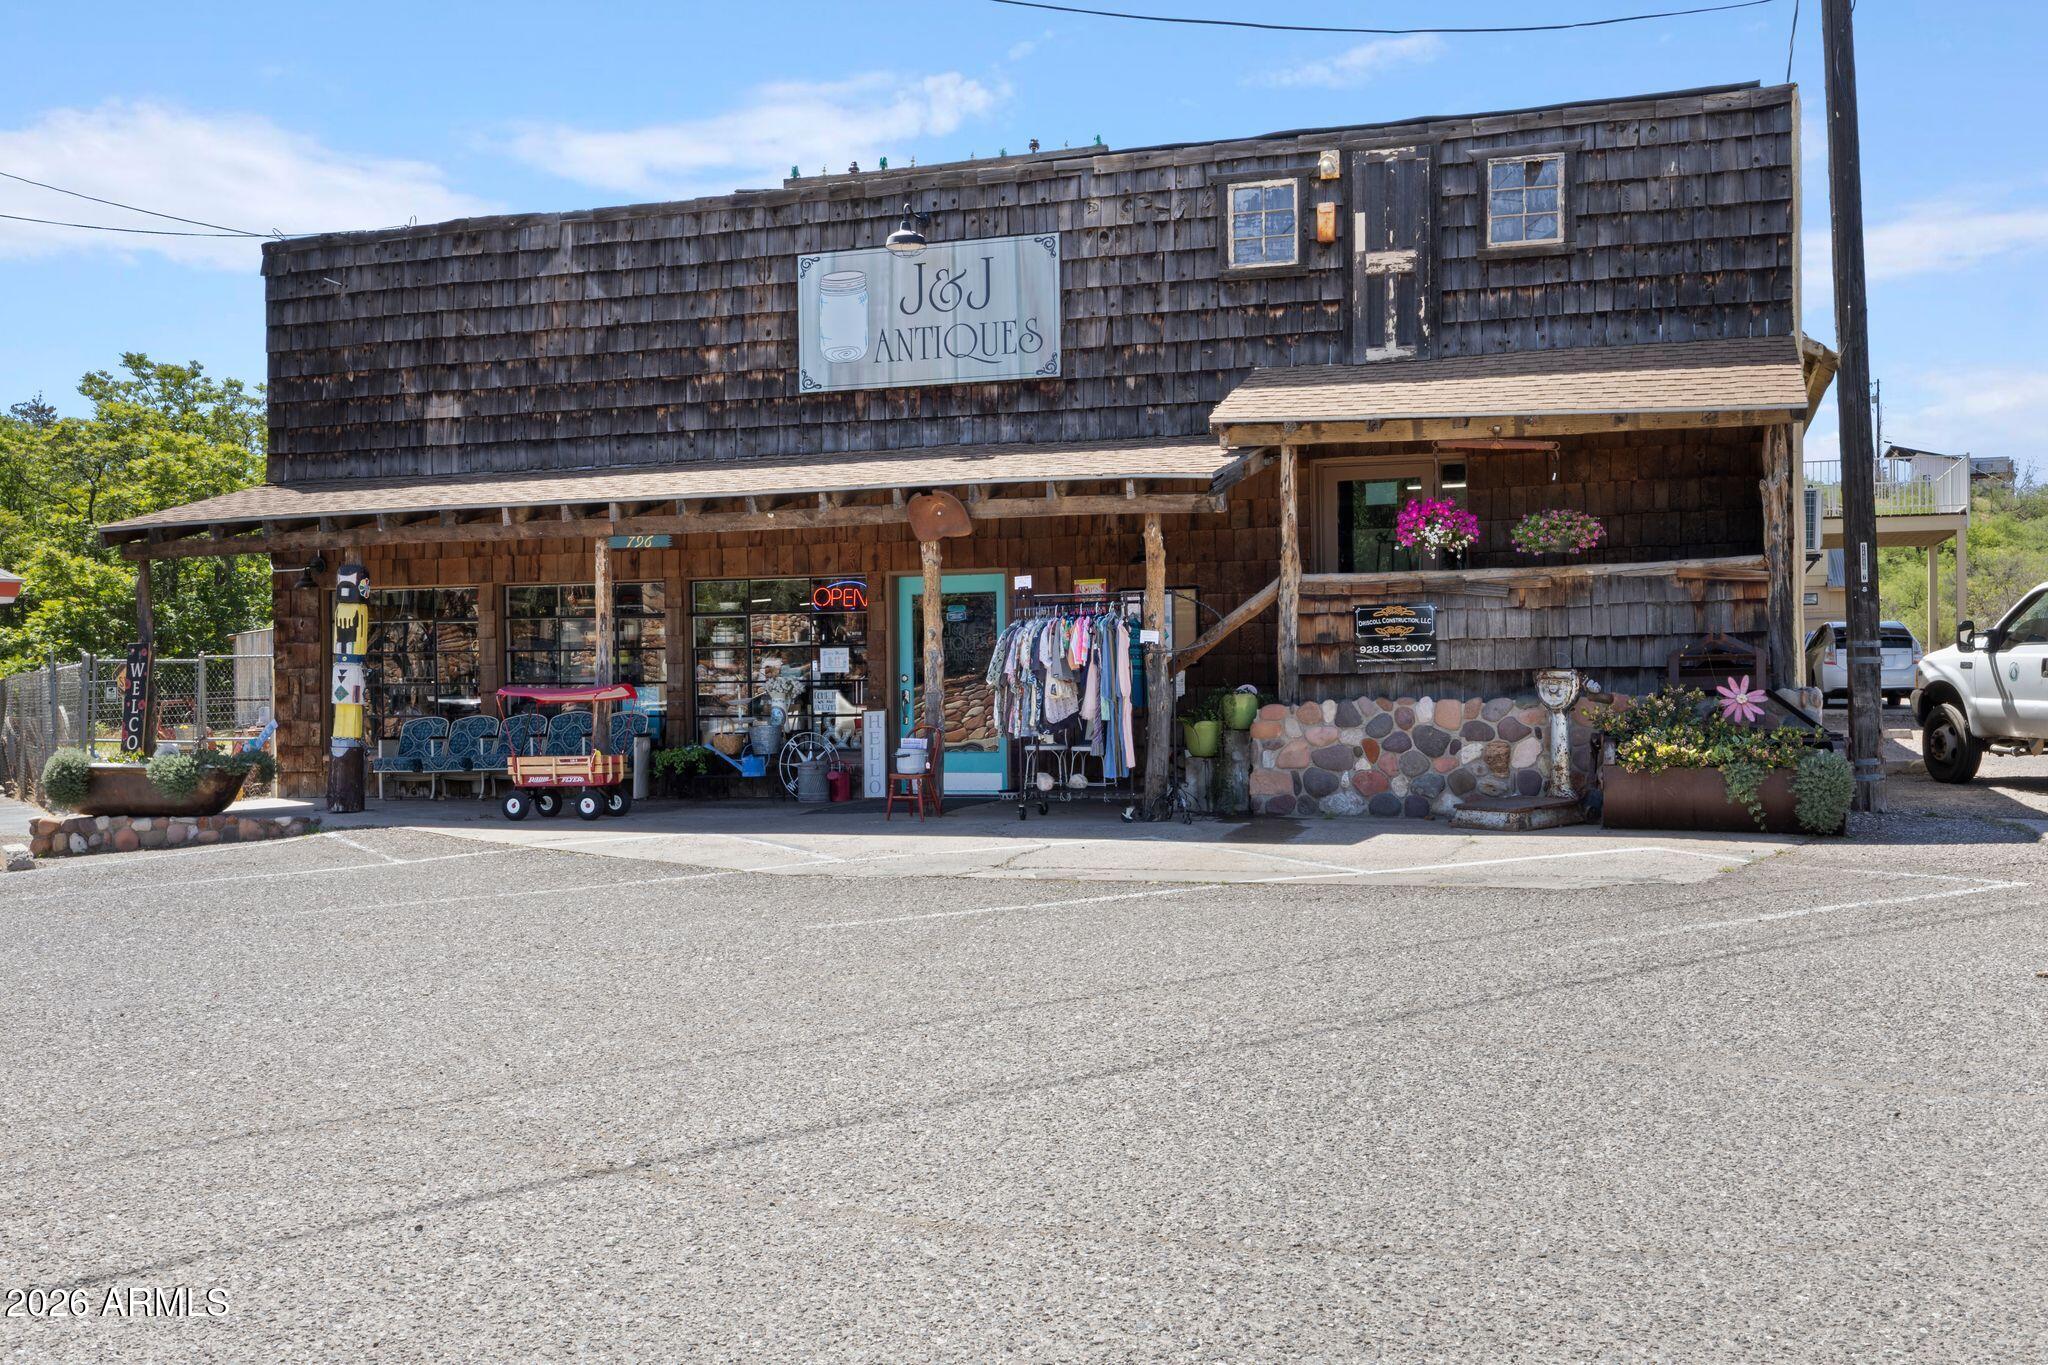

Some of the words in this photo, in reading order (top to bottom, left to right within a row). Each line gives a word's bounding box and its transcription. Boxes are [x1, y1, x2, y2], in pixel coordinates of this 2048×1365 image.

[899, 256, 995, 315] J&J
[873, 316, 1043, 364] ANTIQUES
[626, 535, 654, 548] 796
[813, 586, 868, 607] OPEN
[1420, 616, 1432, 624] LLC
[1359, 643, 1432, 654] 928.852.0007
[868, 714, 882, 794] HELLO
